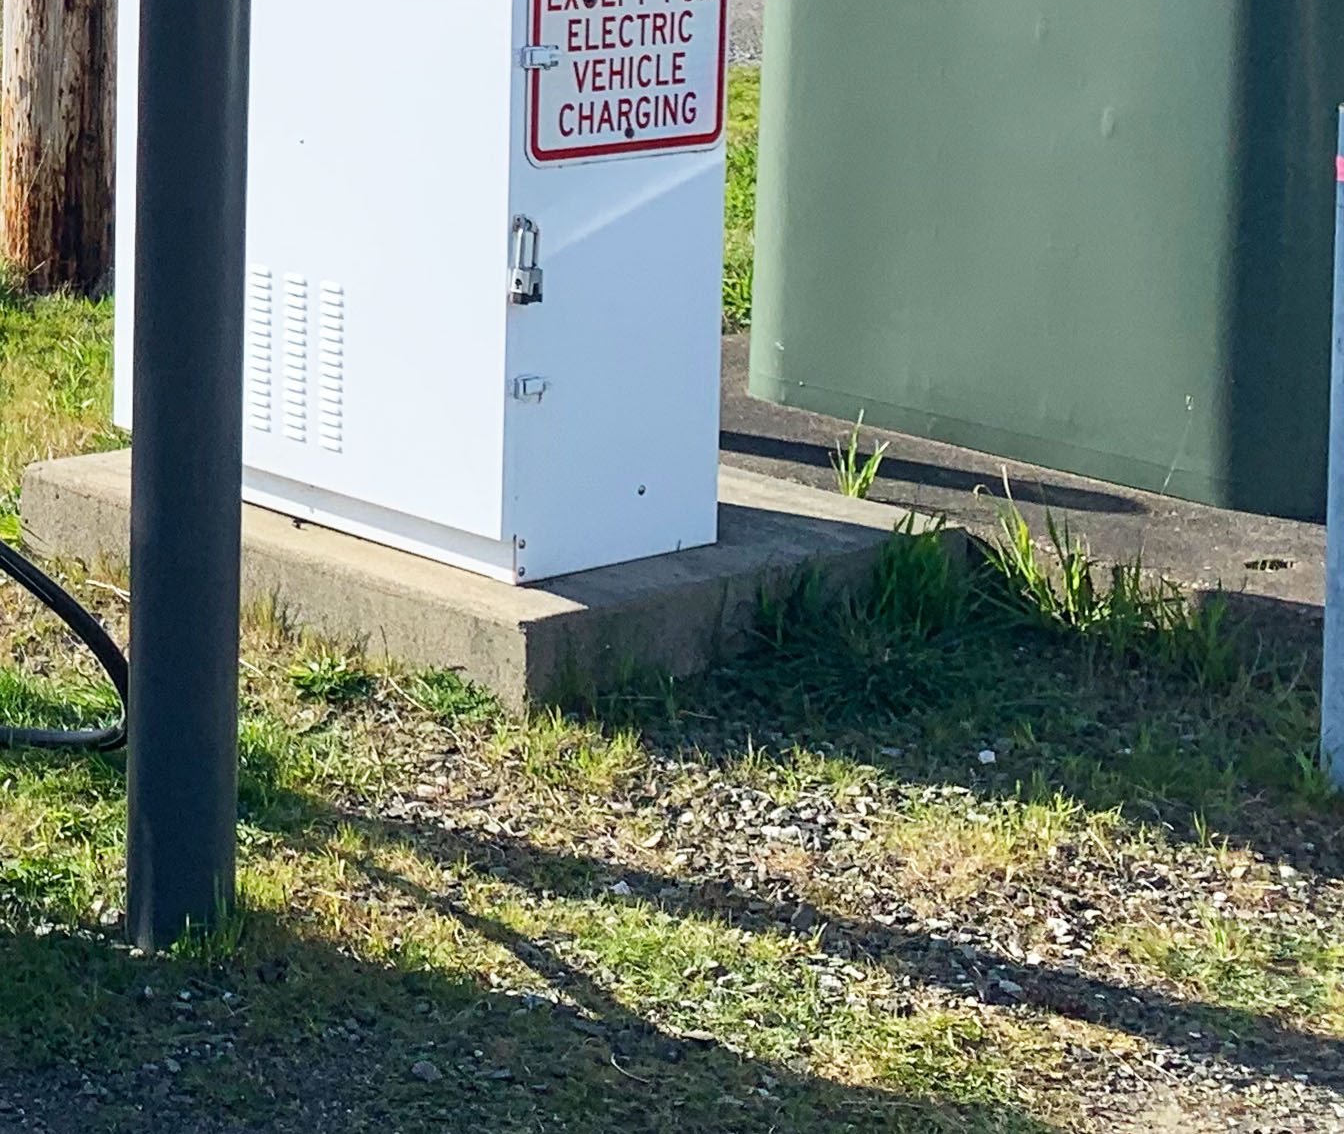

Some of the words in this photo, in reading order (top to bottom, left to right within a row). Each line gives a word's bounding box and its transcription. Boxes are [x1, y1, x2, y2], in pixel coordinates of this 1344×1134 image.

[567, 10, 694, 53] ELECTRIC
[573, 52, 686, 94] VEHICLE
[559, 91, 697, 137] CHARGING
